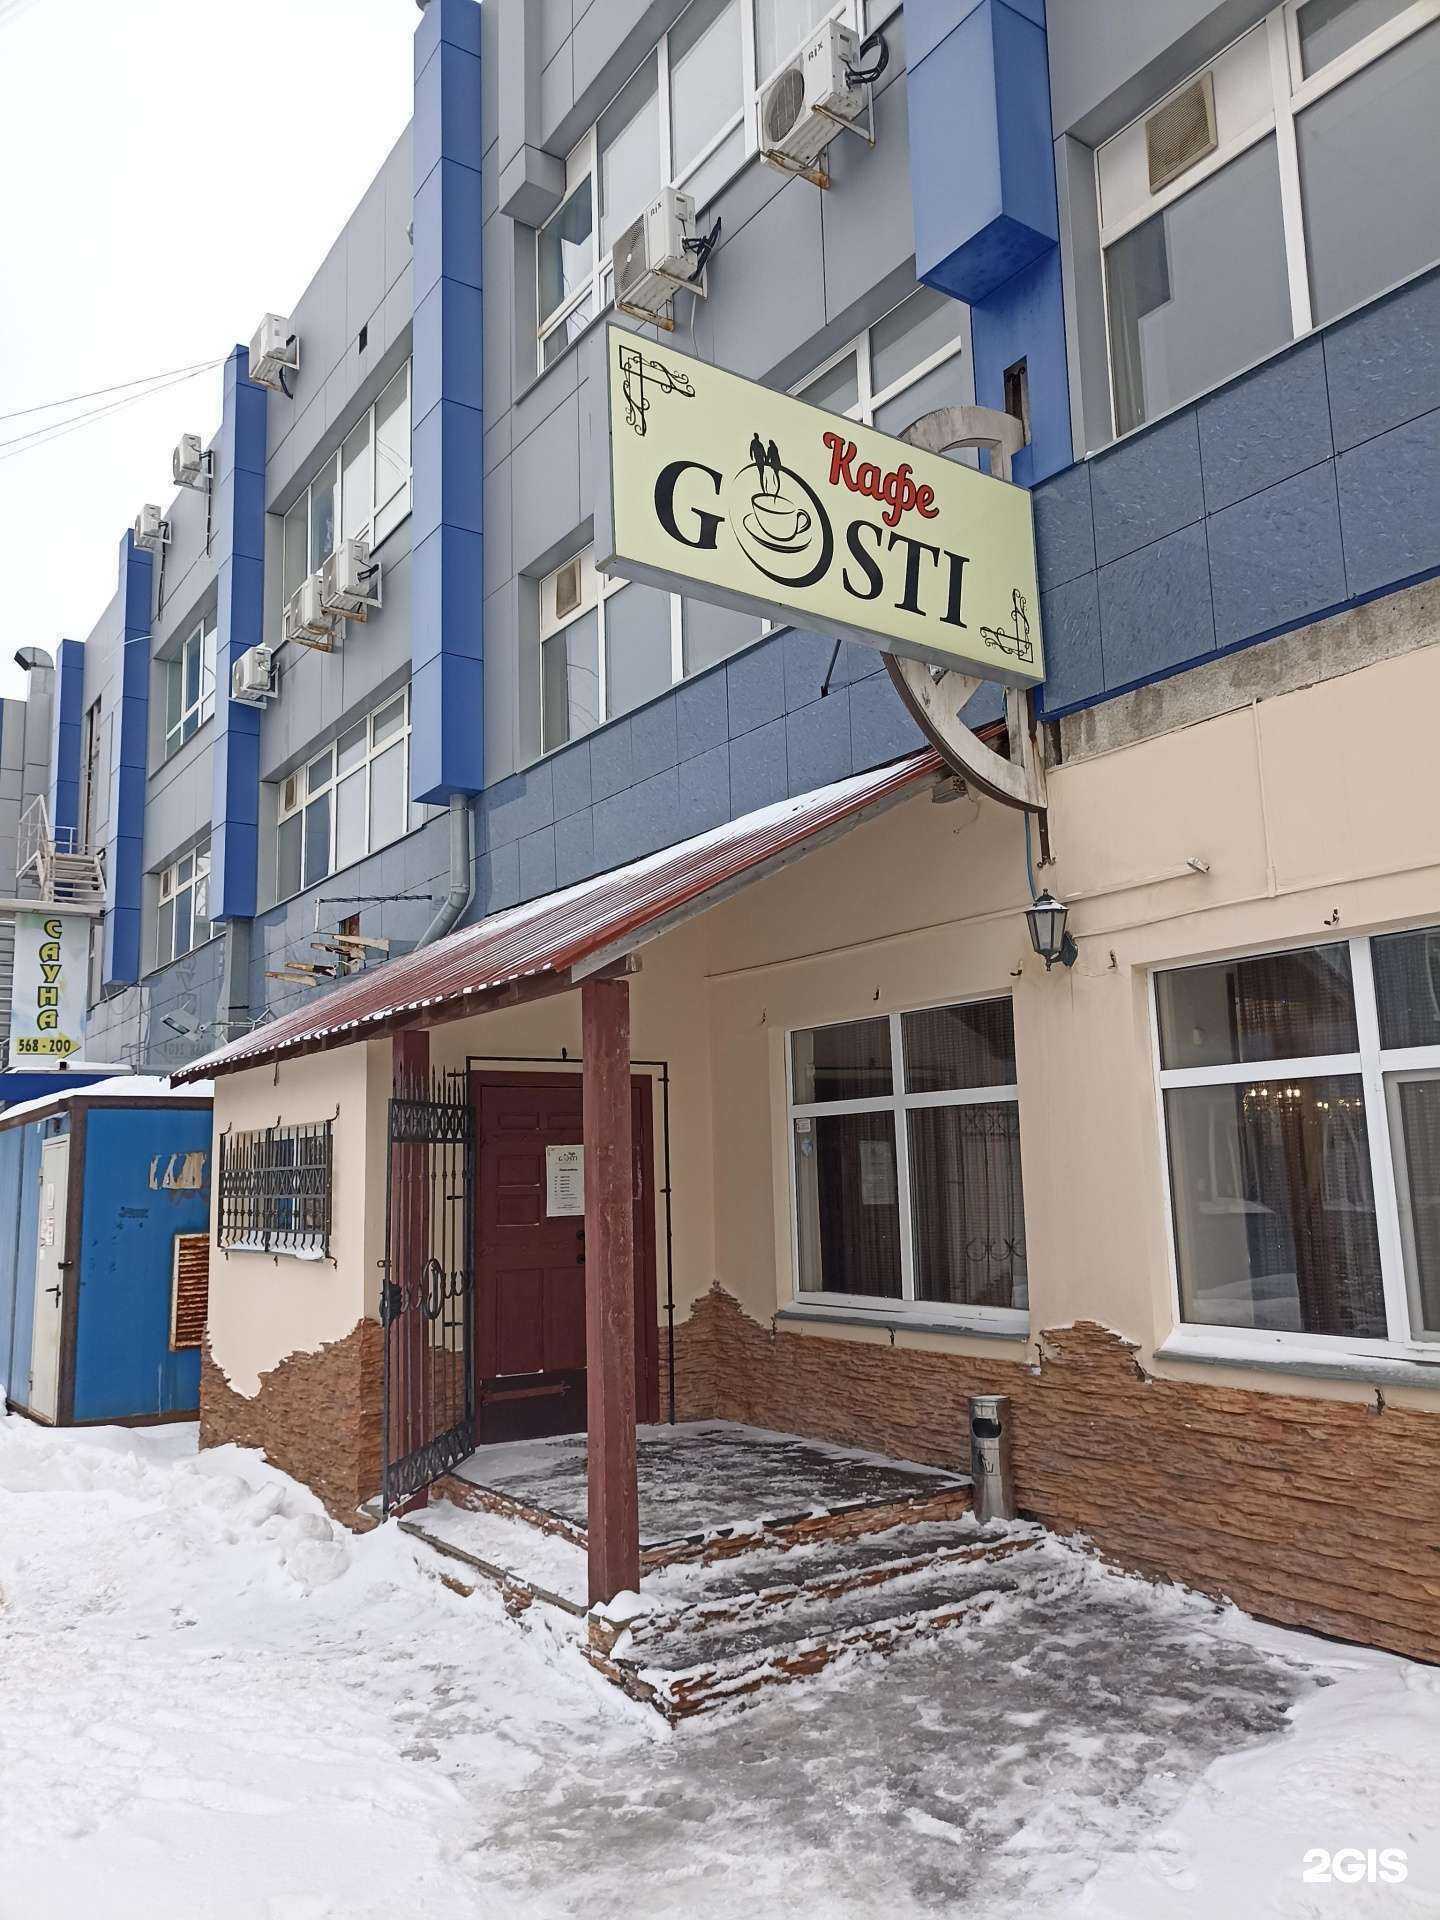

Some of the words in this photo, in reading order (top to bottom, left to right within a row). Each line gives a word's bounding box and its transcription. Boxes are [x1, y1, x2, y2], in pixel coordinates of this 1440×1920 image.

[822, 431, 940, 527] Кафе
[654, 460, 971, 629] GOSTI
[37, 919, 63, 1031] САУНА
